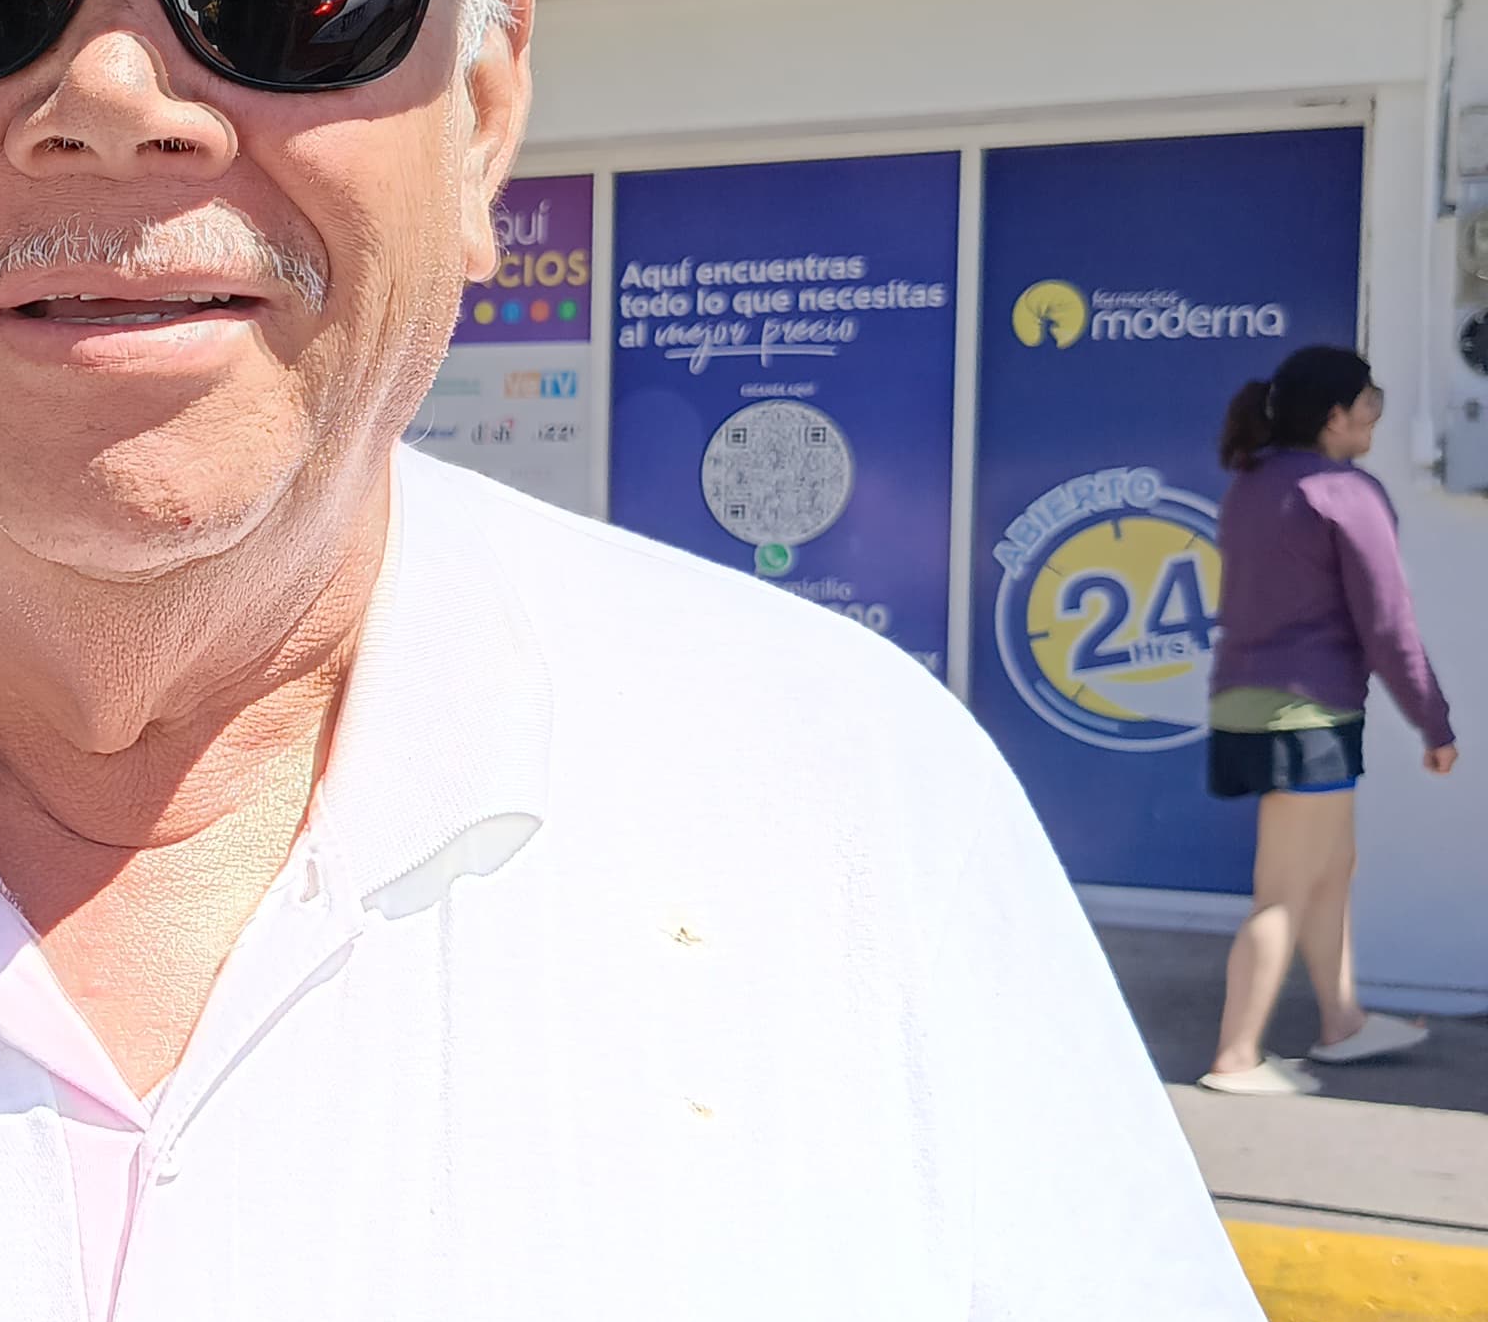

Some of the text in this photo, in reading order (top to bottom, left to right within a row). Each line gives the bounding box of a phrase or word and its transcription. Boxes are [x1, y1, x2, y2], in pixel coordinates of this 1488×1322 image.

[619, 253, 869, 291] Aquí encuentras
[619, 278, 949, 319] todo lo que necesitas
[1091, 299, 1288, 341] moderna
[618, 316, 860, 375] al mejor precio
[993, 467, 1163, 581] ABIERTO
[1062, 554, 1220, 672] 24
